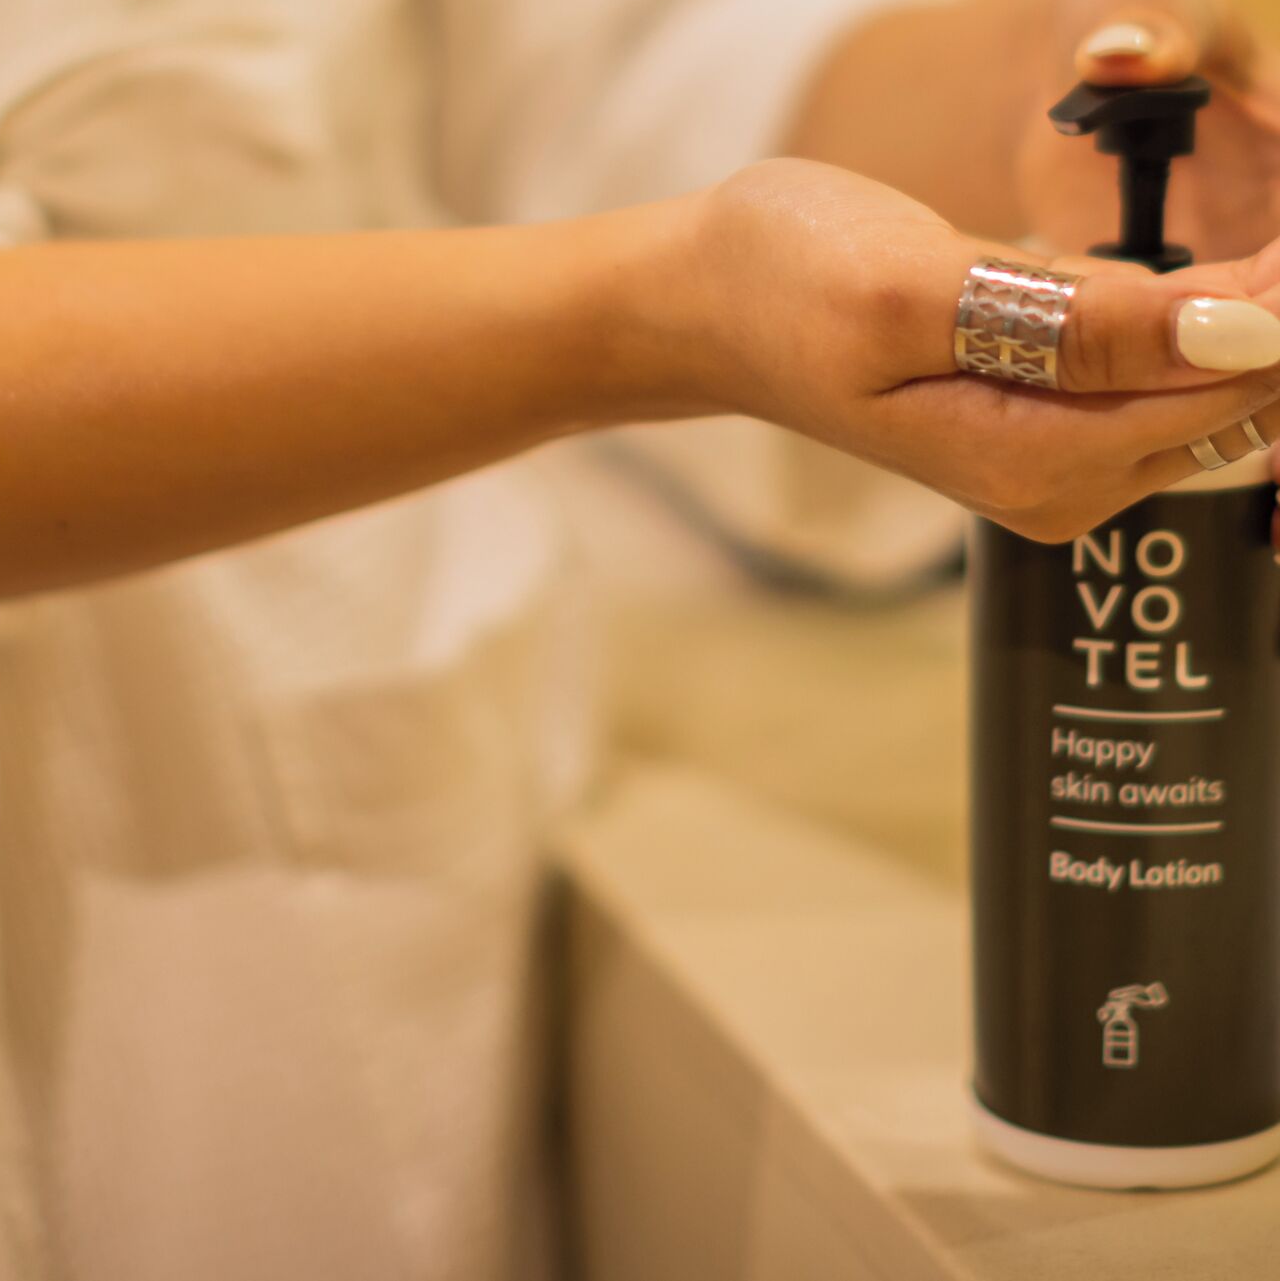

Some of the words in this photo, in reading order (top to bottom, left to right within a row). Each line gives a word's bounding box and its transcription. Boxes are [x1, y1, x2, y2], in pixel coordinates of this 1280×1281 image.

[1072, 529, 1184, 577] NO
[1077, 582, 1181, 632] VO
[1073, 638, 1209, 689] TEL
[1051, 727, 1154, 768] Happy
[1051, 772, 1110, 803] skin
[1118, 776, 1223, 806] awaits
[1049, 851, 1123, 890] Body
[1130, 857, 1221, 888] Lotion
